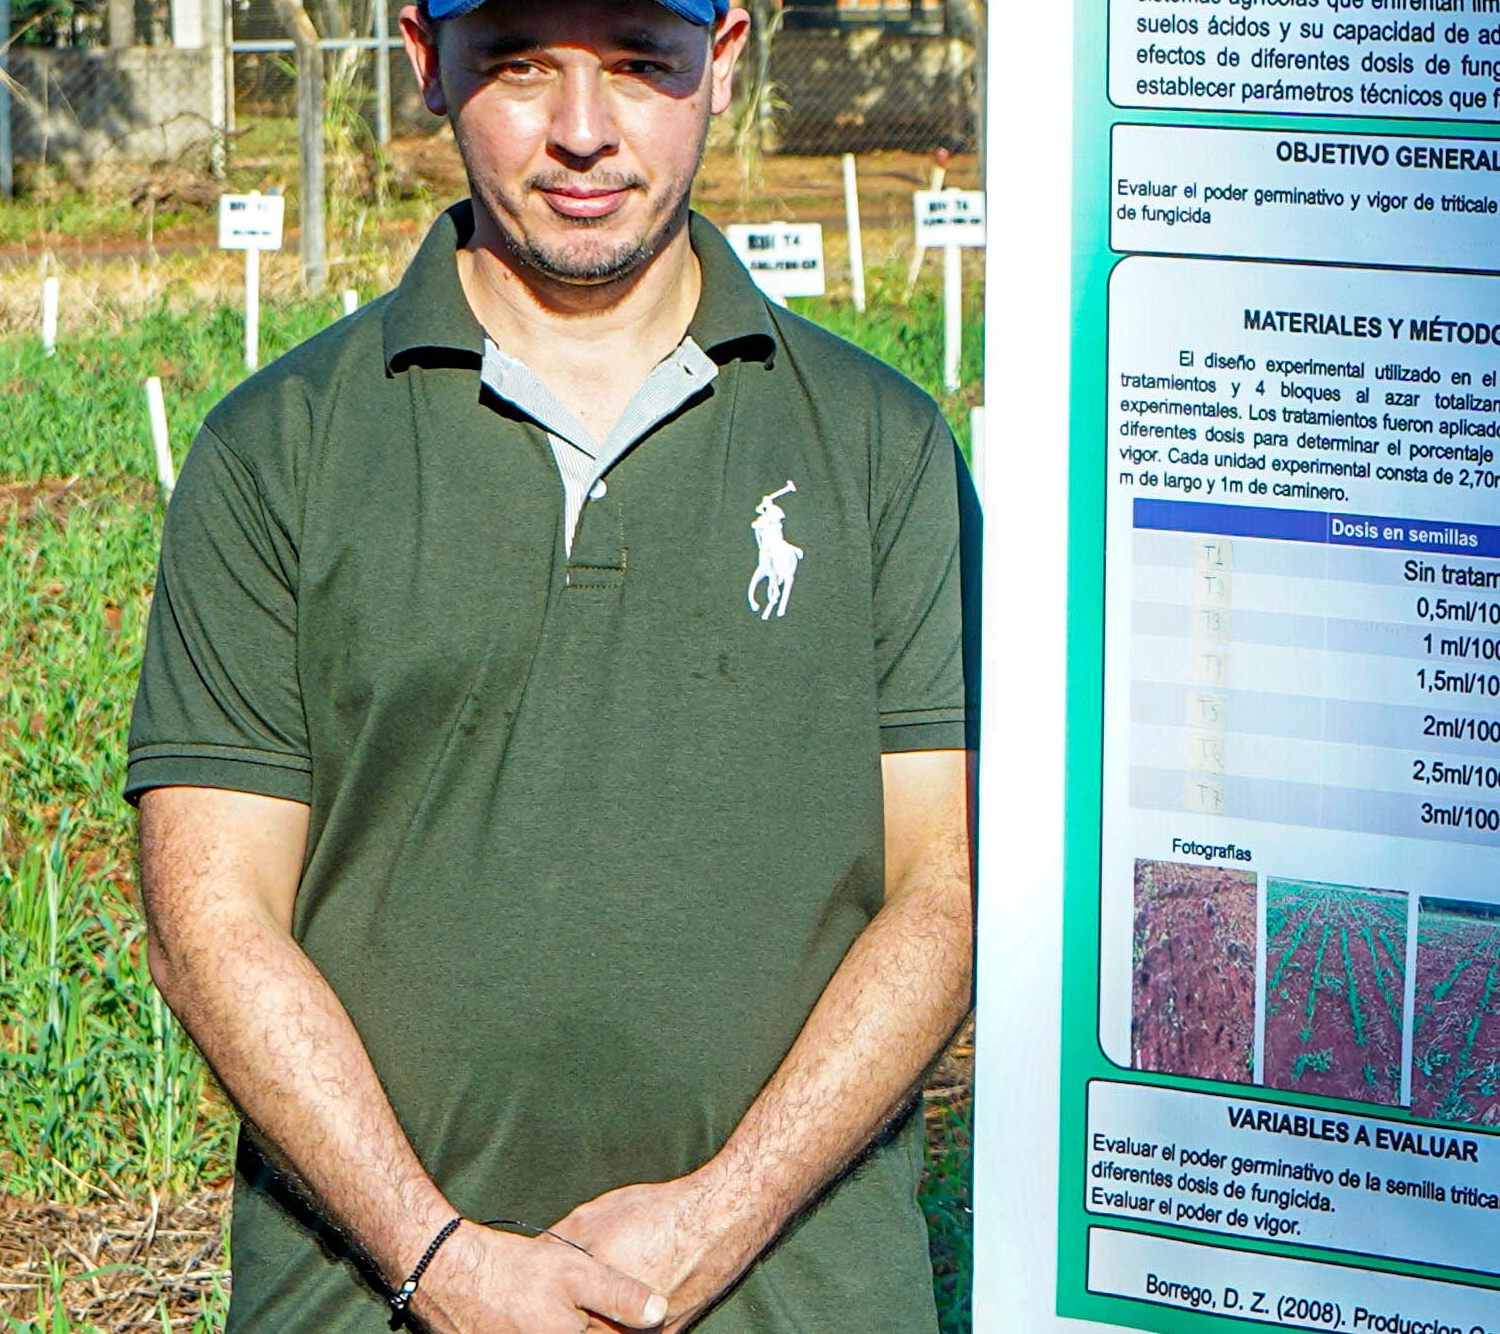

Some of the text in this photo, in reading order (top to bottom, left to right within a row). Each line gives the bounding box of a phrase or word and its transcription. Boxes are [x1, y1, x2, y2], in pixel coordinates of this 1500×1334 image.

[1276, 141, 1389, 166] OBJETIVO
[1244, 309, 1382, 338] MATERIALES
[1388, 318, 1404, 339] Y
[1332, 519, 1478, 547] Dosis en semillas
[1404, 560, 1435, 583] Sin
[1424, 633, 1432, 654] 1
[1173, 838, 1252, 861] Fotografías
[1228, 1107, 1478, 1163] VARIABLES A EVALUAR
